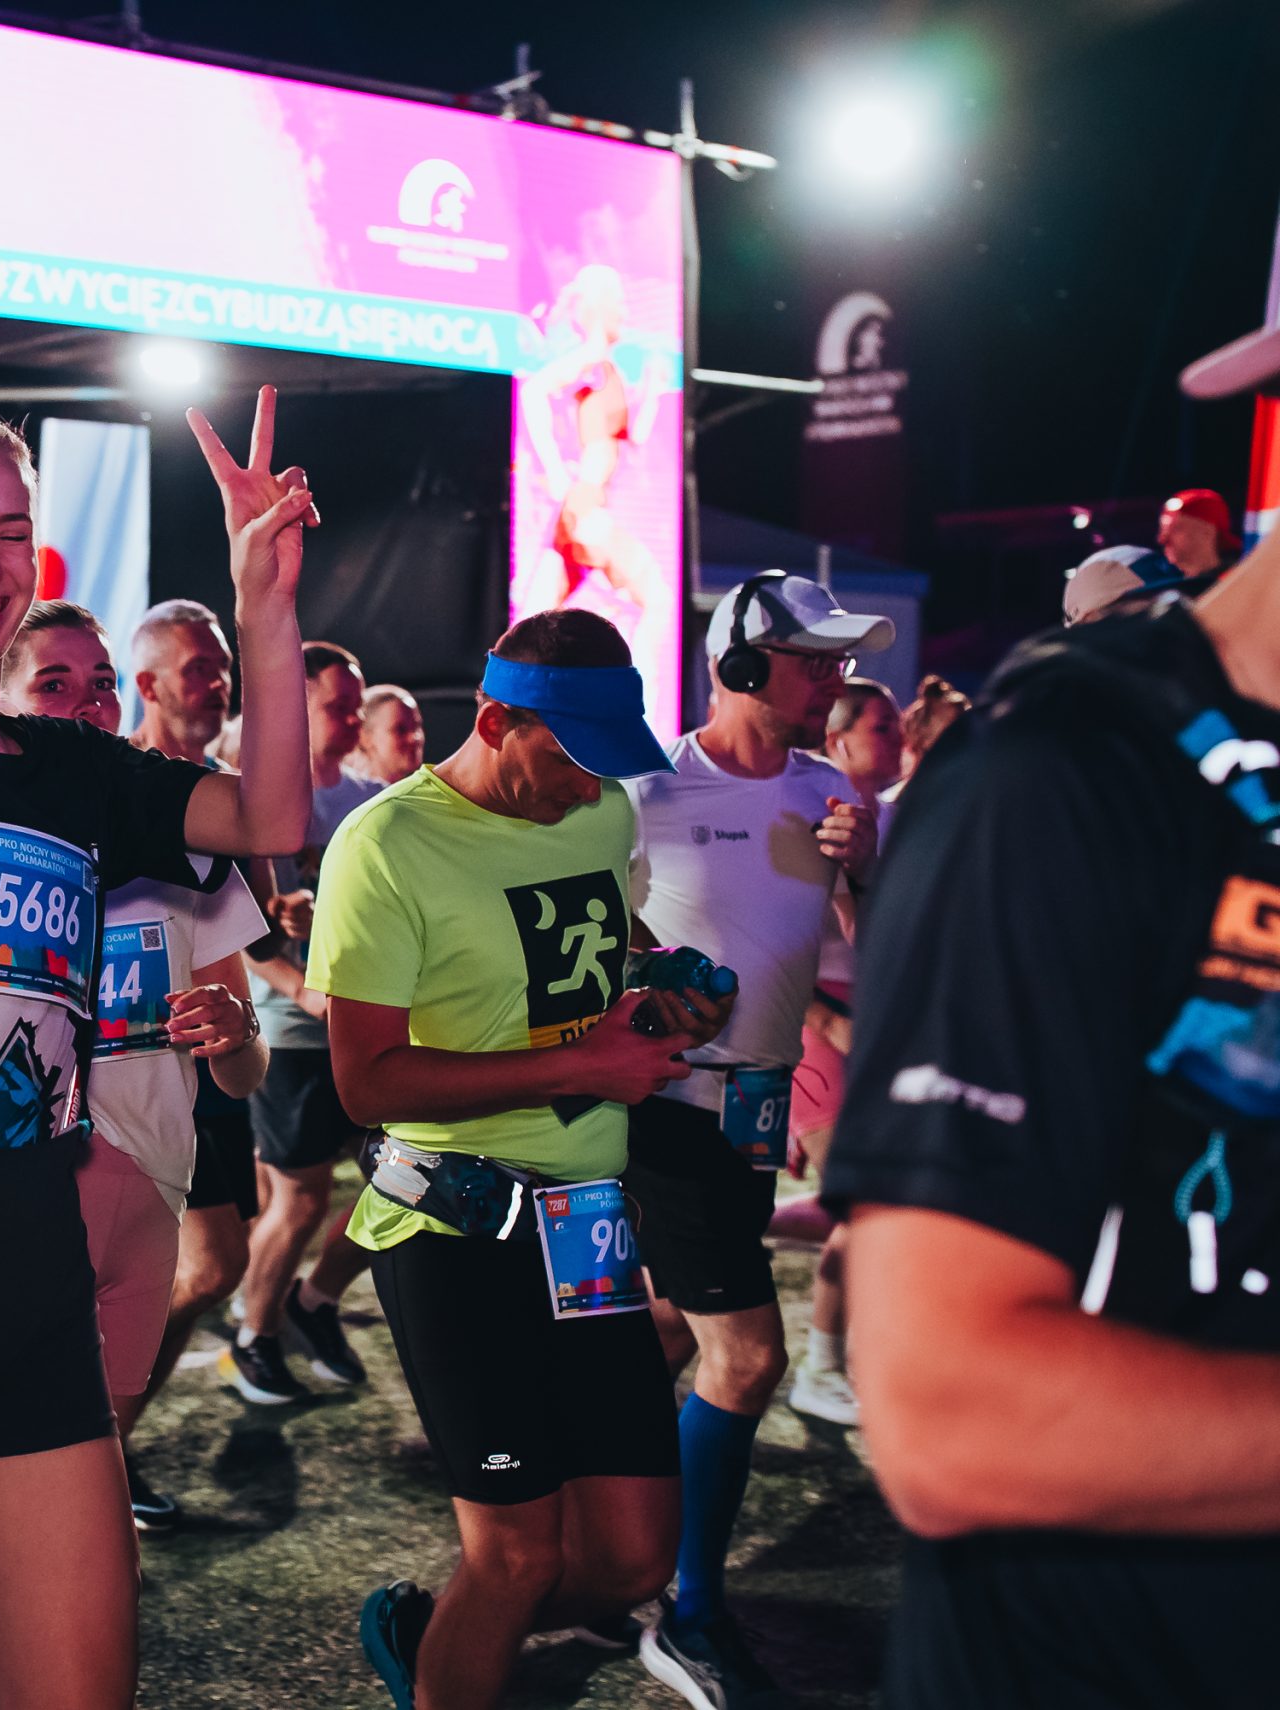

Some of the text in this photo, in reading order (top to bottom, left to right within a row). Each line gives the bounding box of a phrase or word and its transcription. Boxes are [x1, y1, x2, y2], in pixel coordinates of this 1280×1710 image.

[12, 851, 66, 876] PÓŁMARATON
[19, 842, 49, 857] NOCNY
[50, 850, 82, 871] WROCŁAW
